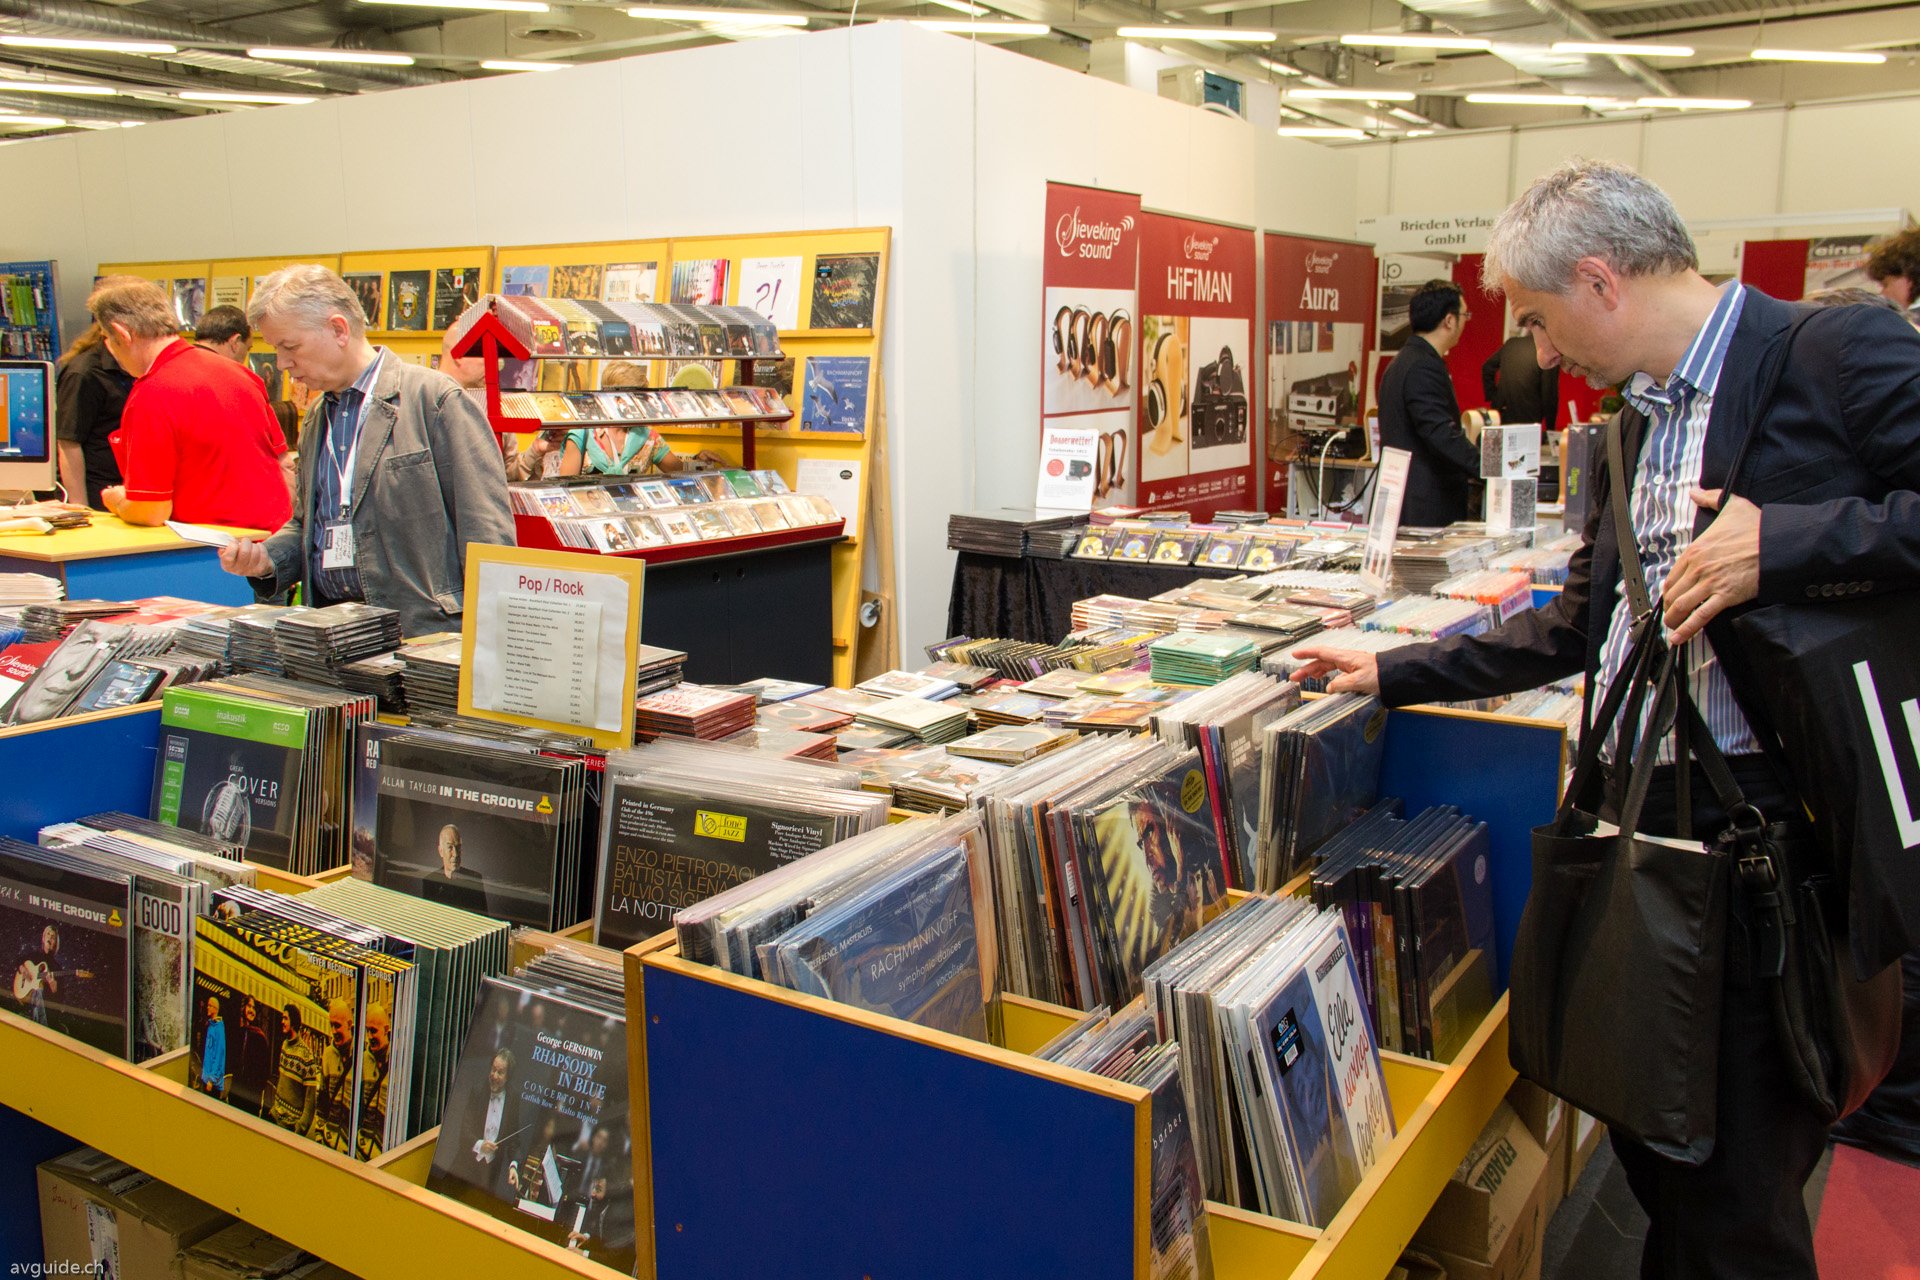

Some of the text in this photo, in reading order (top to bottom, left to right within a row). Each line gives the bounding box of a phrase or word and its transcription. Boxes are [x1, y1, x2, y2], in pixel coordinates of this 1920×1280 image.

[1055, 205, 1121, 257] Sieveking
[1400, 217, 1495, 232] Brieden Verlag
[1079, 243, 1112, 260] sound
[1183, 231, 1213, 259] Sieveking
[1424, 234, 1466, 246] GmbH
[1167, 265, 1232, 303] HiFiMAN
[1299, 277, 1339, 312] Aura
[518, 575, 543, 595] Pop
[553, 578, 584, 596] Rock
[228, 773, 278, 799] COVER
[381, 776, 405, 789] ALLAN
[409, 780, 437, 795] TAYLOR
[439, 785, 453, 797] IN
[454, 788, 480, 803] THE
[481, 793, 534, 812] GROOVE
[621, 798, 642, 809] Printed
[650, 803, 675, 814] Germany
[723, 829, 740, 838] JAZZ
[806, 826, 823, 837] Vinyl
[616, 845, 658, 867] ENZO
[612, 878, 664, 903] FULVIO
[614, 861, 728, 895] BATTISTA LENA
[29, 894, 40, 905] IN
[41, 897, 62, 913] THE
[63, 904, 107, 924] GROOVE
[141, 895, 181, 935] GOOD
[611, 895, 629, 914] LA
[870, 909, 959, 982] RACHMANINOFF
[936, 940, 962, 963] dances
[307, 953, 354, 978] MEYER RECORDS
[1327, 992, 1354, 1062] Ella
[537, 1031, 604, 1061] George GERSHWIN
[531, 1045, 597, 1080] RHAPSODY
[524, 1080, 602, 1114] CONCERTO IN F
[557, 1071, 607, 1100] IN BLUE
[521, 1091, 598, 1125] Catfish Row Rialto Ripples
[1152, 1112, 1183, 1149] barber
